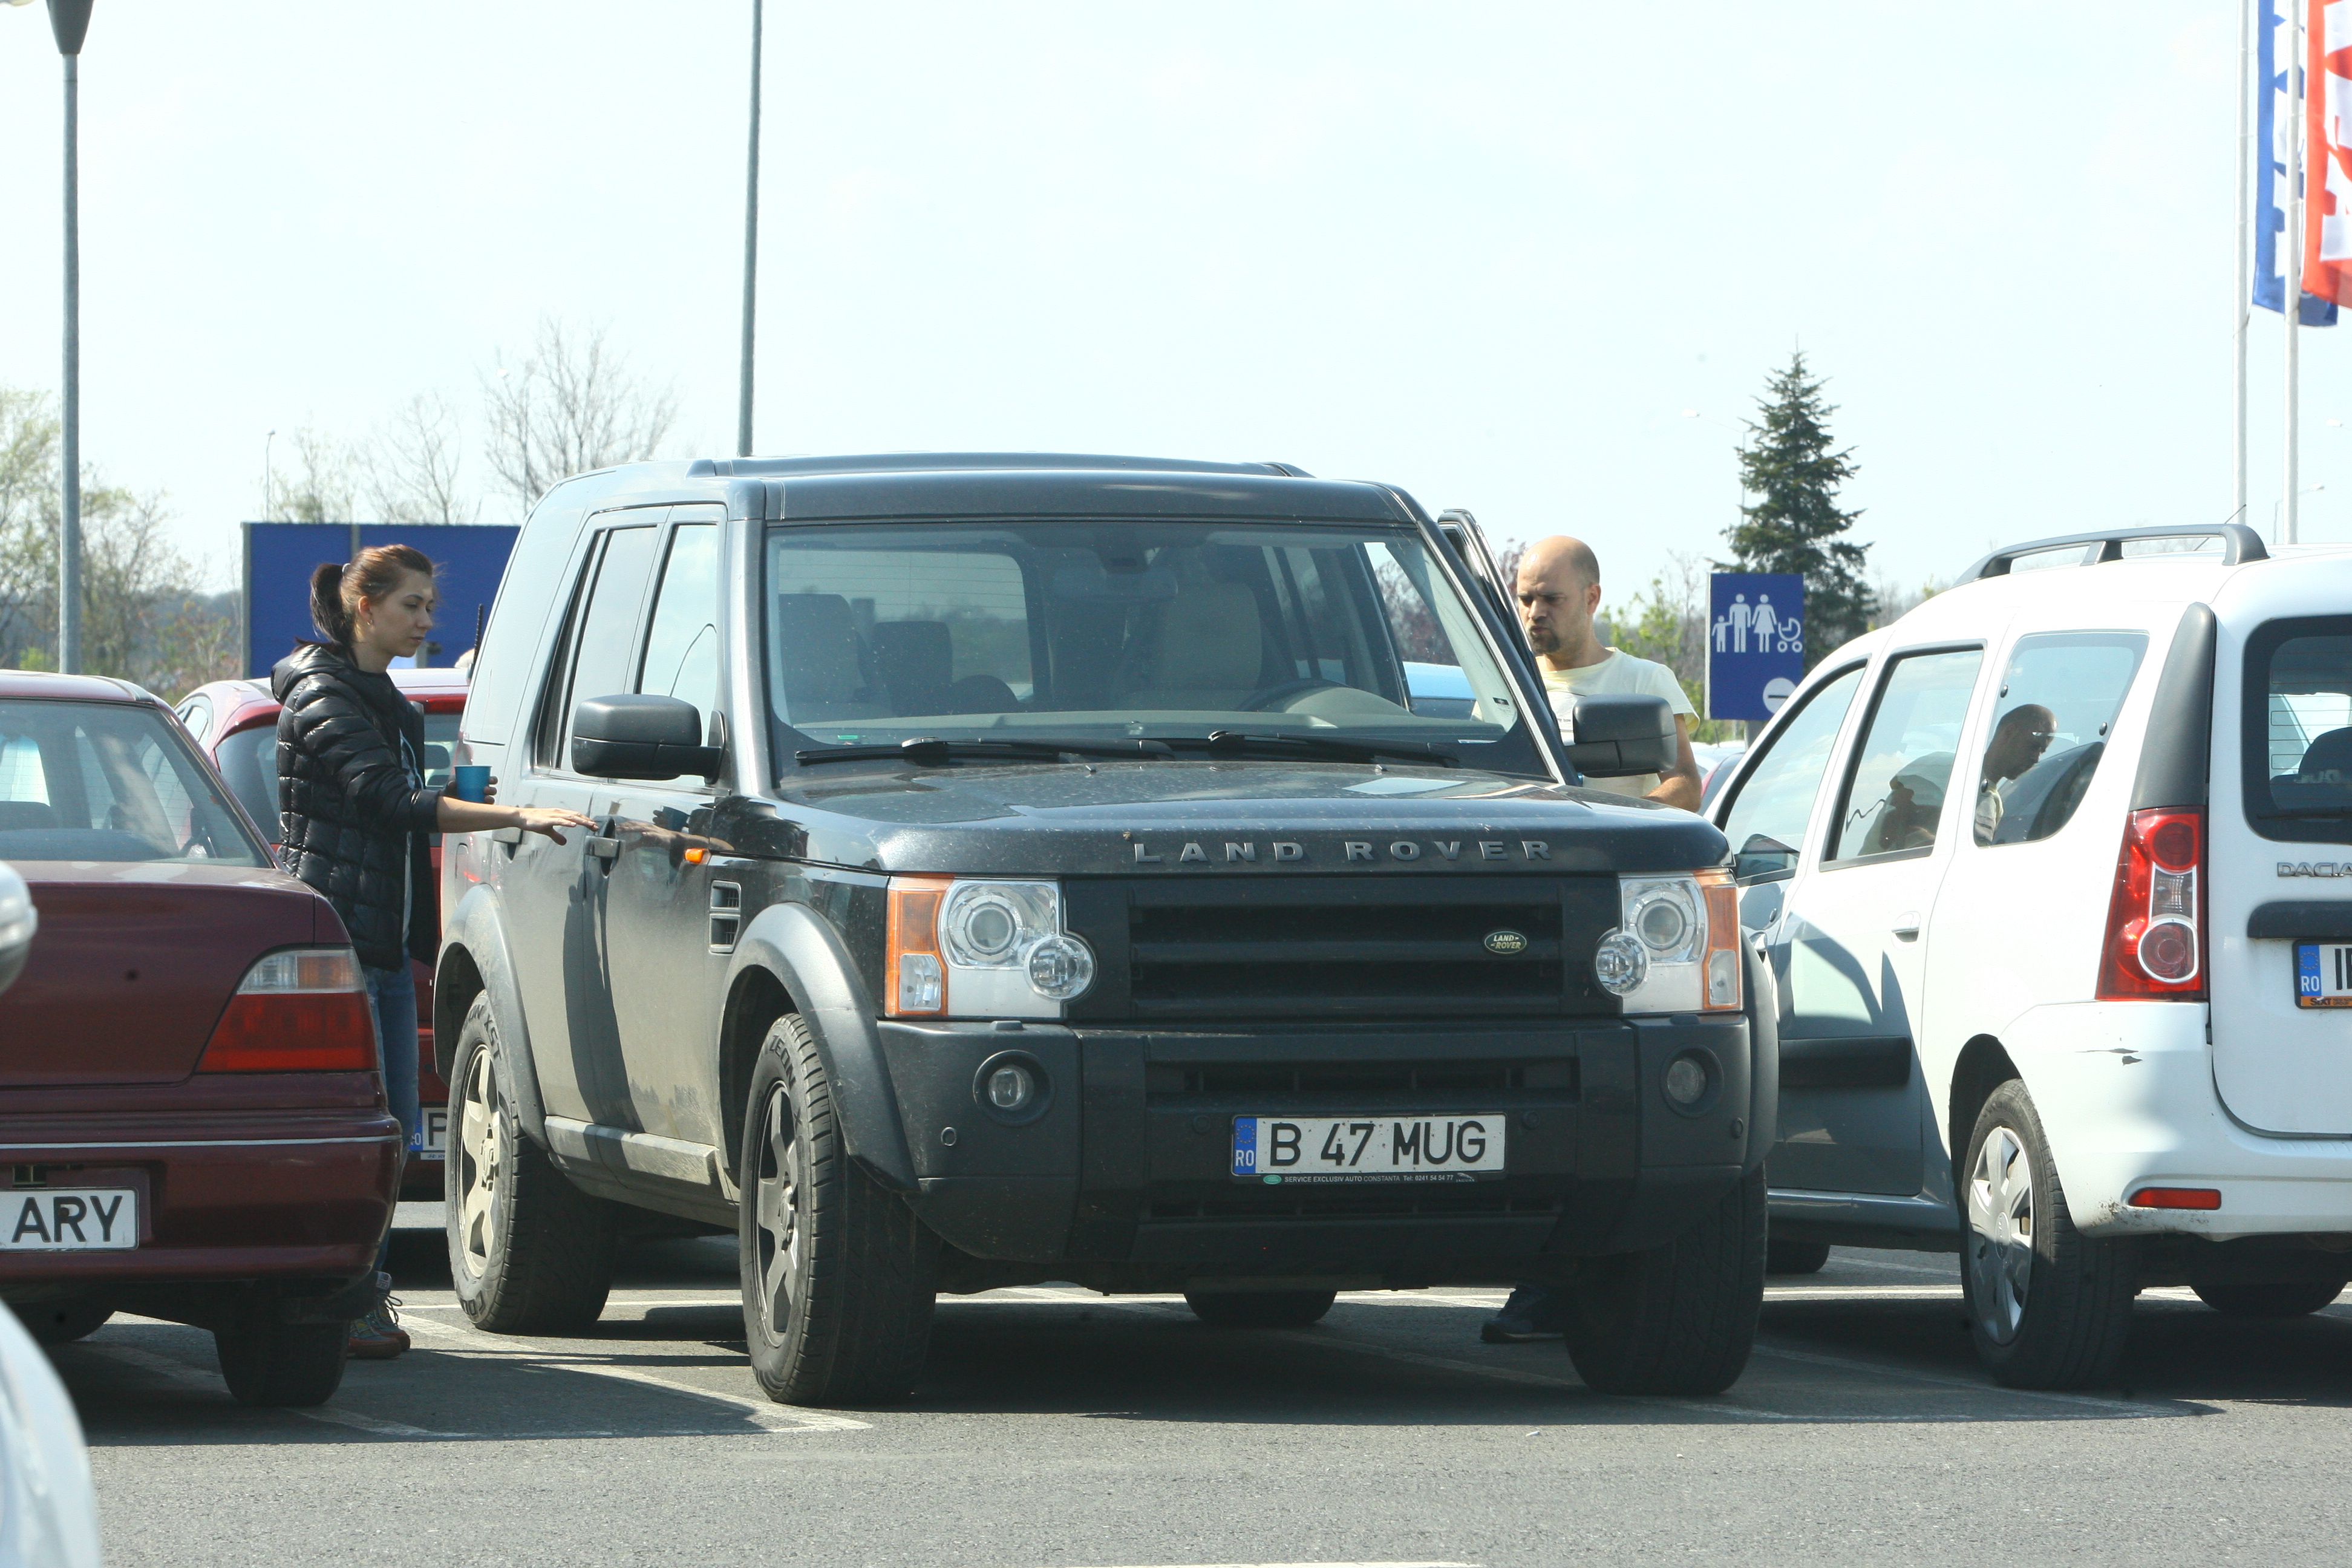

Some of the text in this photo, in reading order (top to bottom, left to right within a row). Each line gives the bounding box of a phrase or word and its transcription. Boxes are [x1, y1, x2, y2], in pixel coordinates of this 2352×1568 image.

[1135, 840, 1552, 863] LAND ROVER
[2277, 862, 2352, 877] DACIA
[2301, 975, 2320, 991] RO
[2335, 947, 2352, 990] I
[769, 1034, 796, 1089] ZEON
[1235, 1149, 1255, 1168] RO
[1270, 1121, 1486, 1166] B 47 MUG
[11, 1195, 123, 1243] ARY
